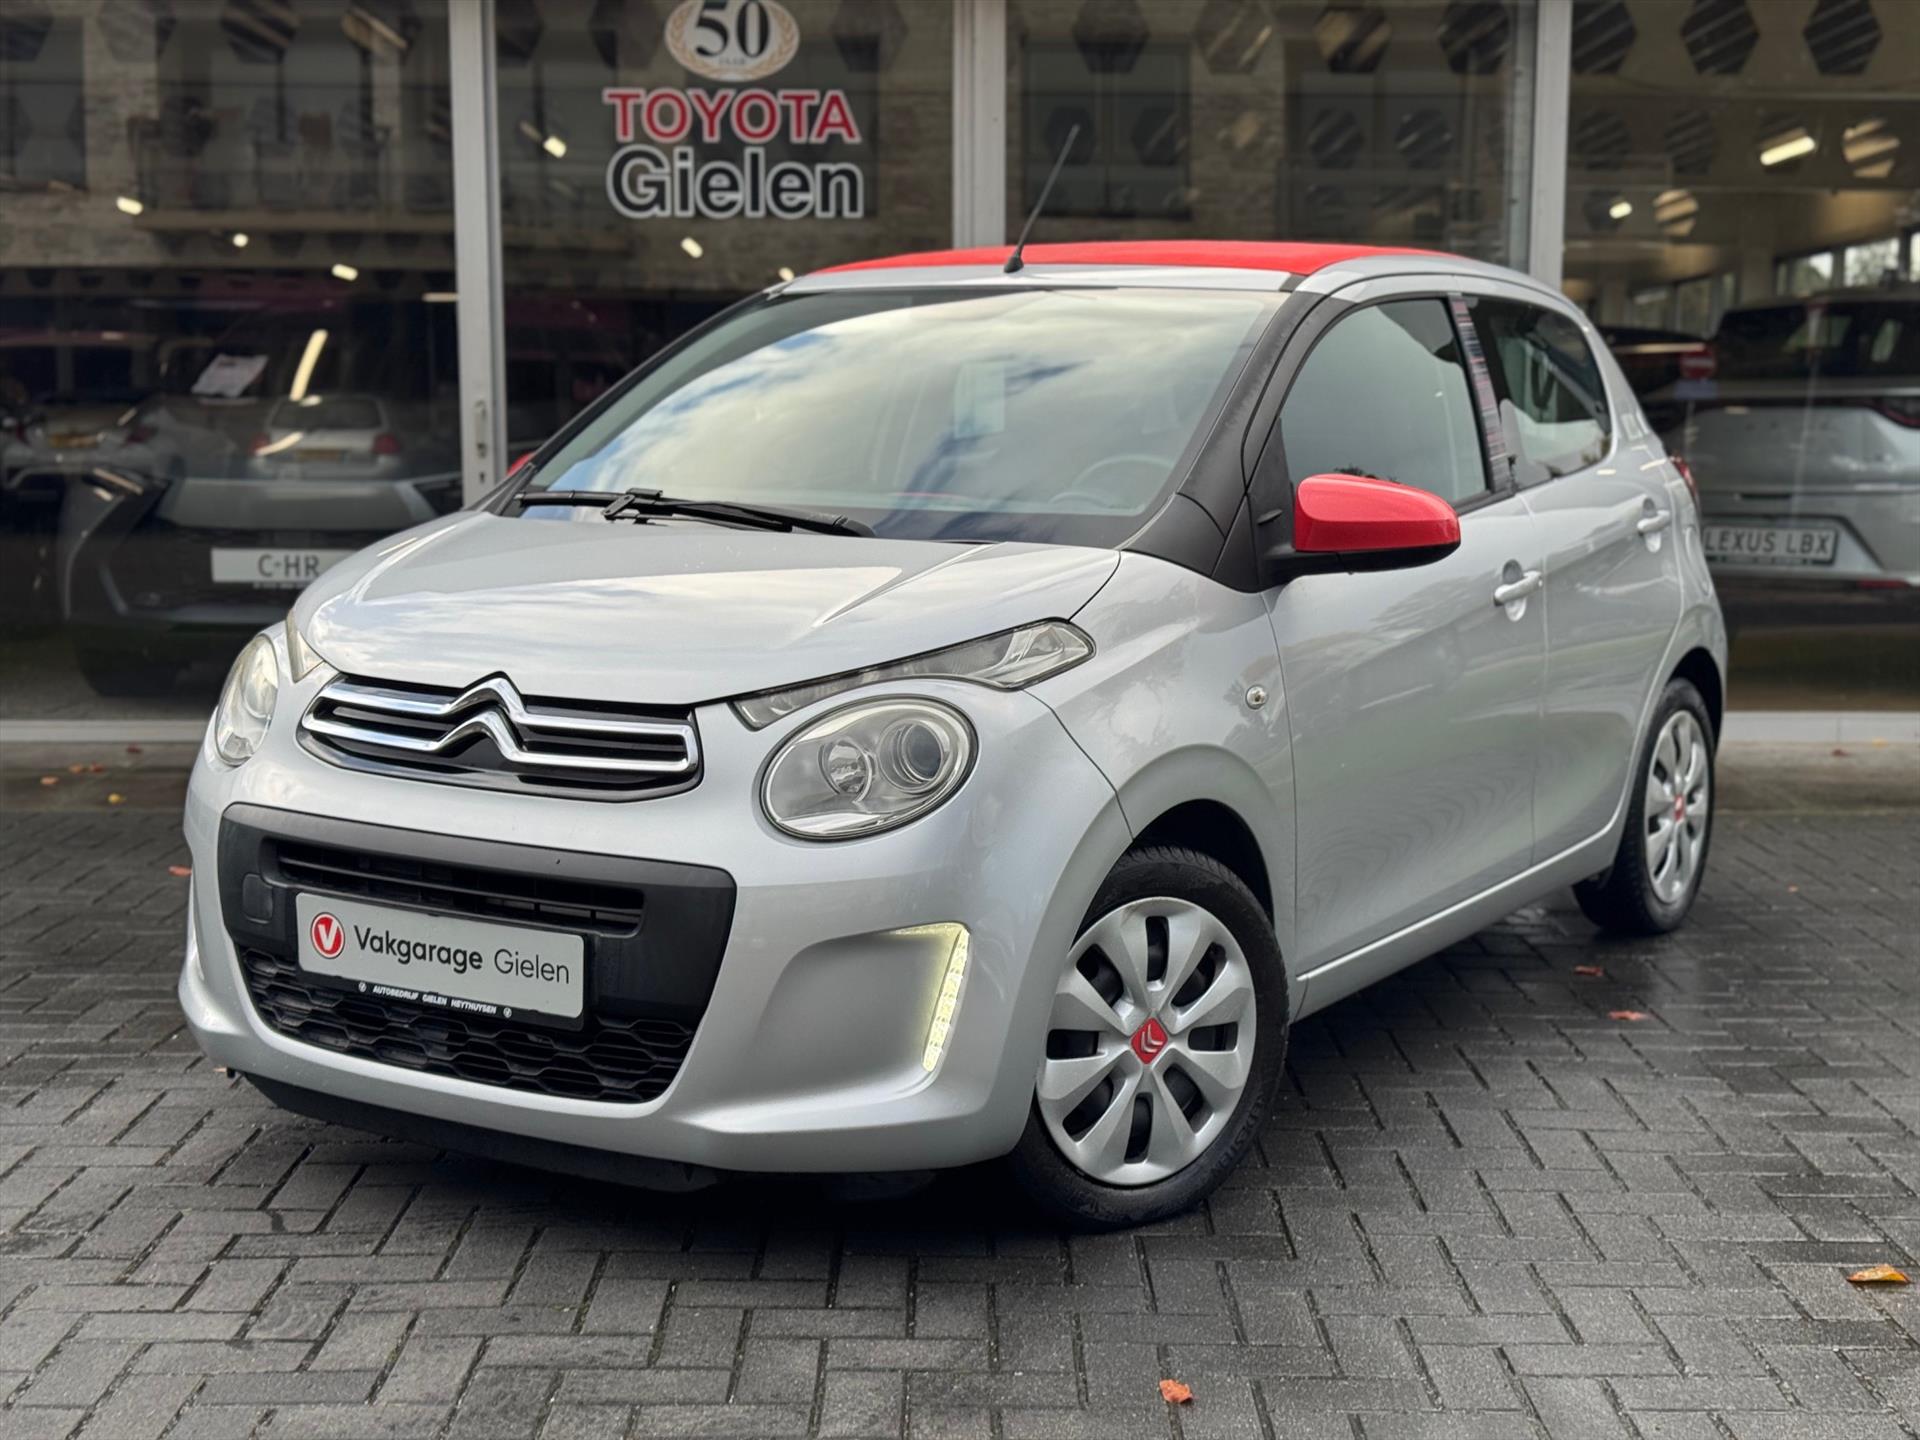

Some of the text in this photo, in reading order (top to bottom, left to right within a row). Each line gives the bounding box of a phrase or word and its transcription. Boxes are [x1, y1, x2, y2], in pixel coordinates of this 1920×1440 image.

[695, 0, 770, 58] 50
[603, 88, 861, 143] TOYOTA
[606, 144, 864, 219] Gielen
[1705, 531, 1830, 554] LEXUS LBX
[354, 925, 570, 984] Vakgarage Gielen
[372, 985, 419, 1000] AUTOBEDRIJF
[422, 993, 448, 1006] GIELEN
